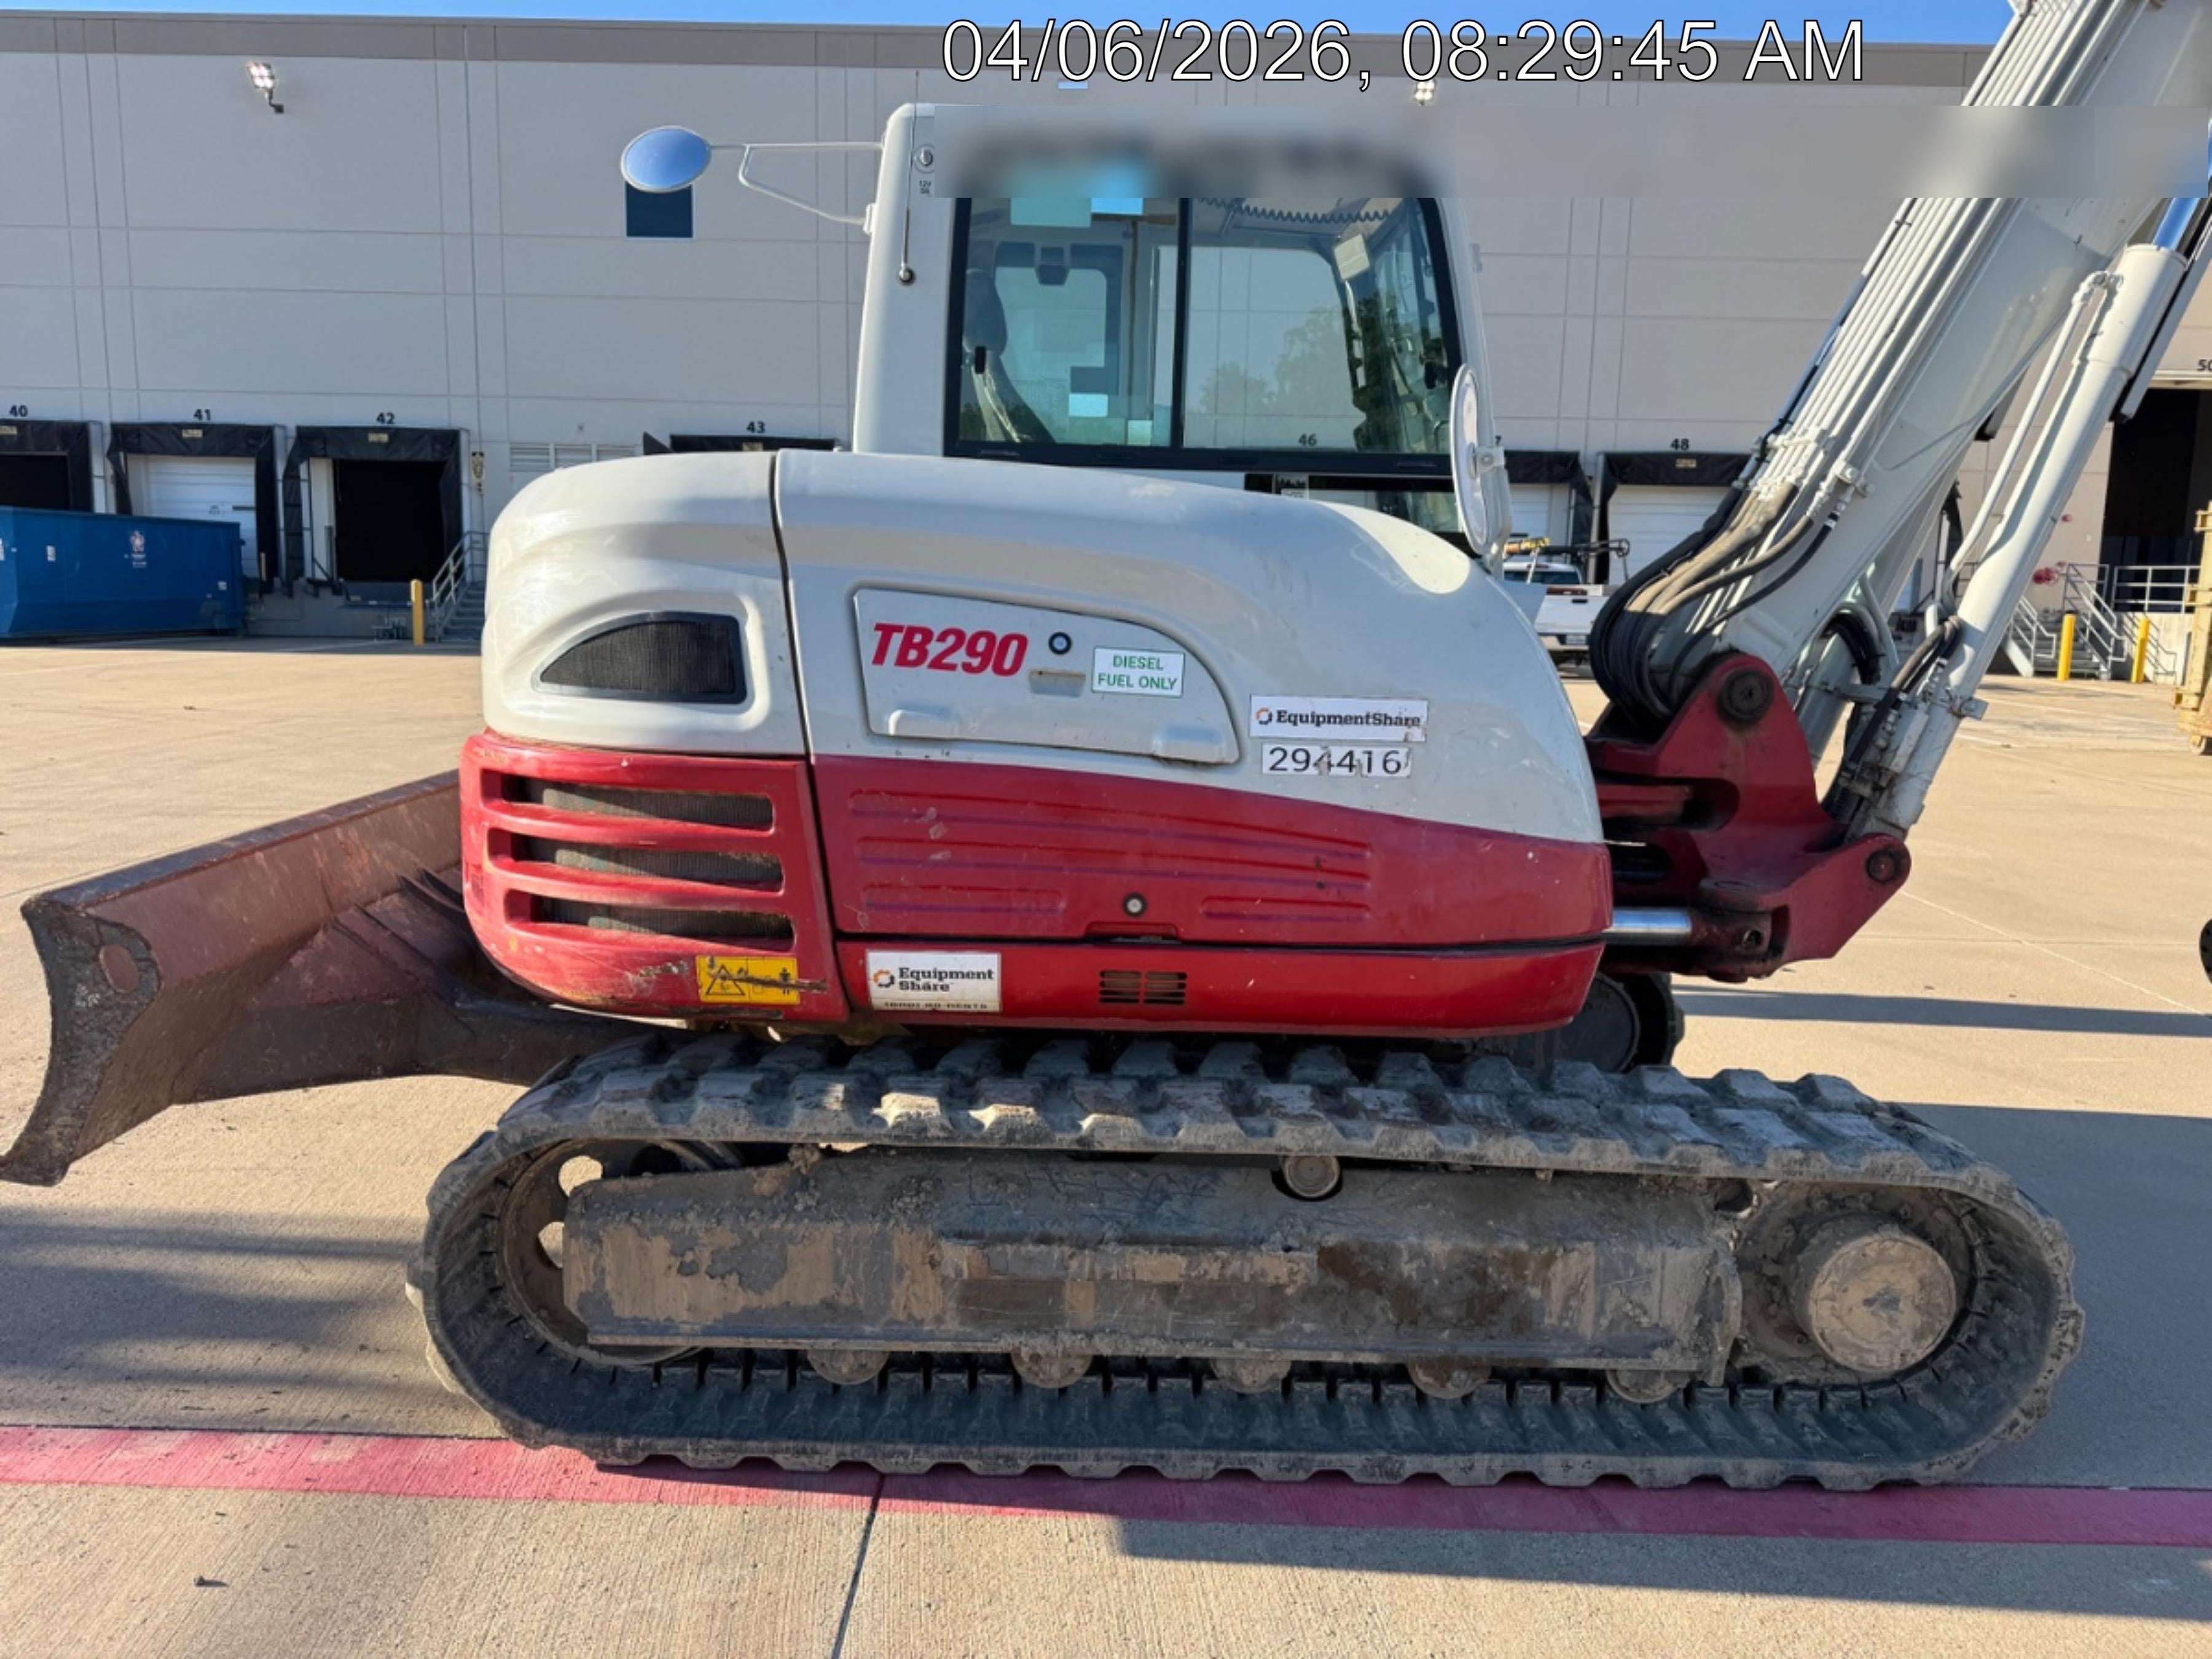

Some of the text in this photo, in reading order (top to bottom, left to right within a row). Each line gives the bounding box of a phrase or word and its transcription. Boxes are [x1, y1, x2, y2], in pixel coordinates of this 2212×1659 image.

[9, 404, 28, 417] 40
[193, 409, 211, 421] 41
[376, 412, 395, 425] 42
[746, 421, 766, 434] 43
[1298, 433, 1317, 447] 46
[1670, 438, 1689, 450] 48
[871, 622, 1029, 677] TB290
[1112, 654, 1164, 671] DIESEL
[1098, 672, 1178, 691] FUEL ONLY
[1276, 709, 1421, 728] EquipmentShare
[1268, 746, 1402, 775] 294416
[898, 967, 994, 982] Equipment
[899, 981, 950, 992] Share
